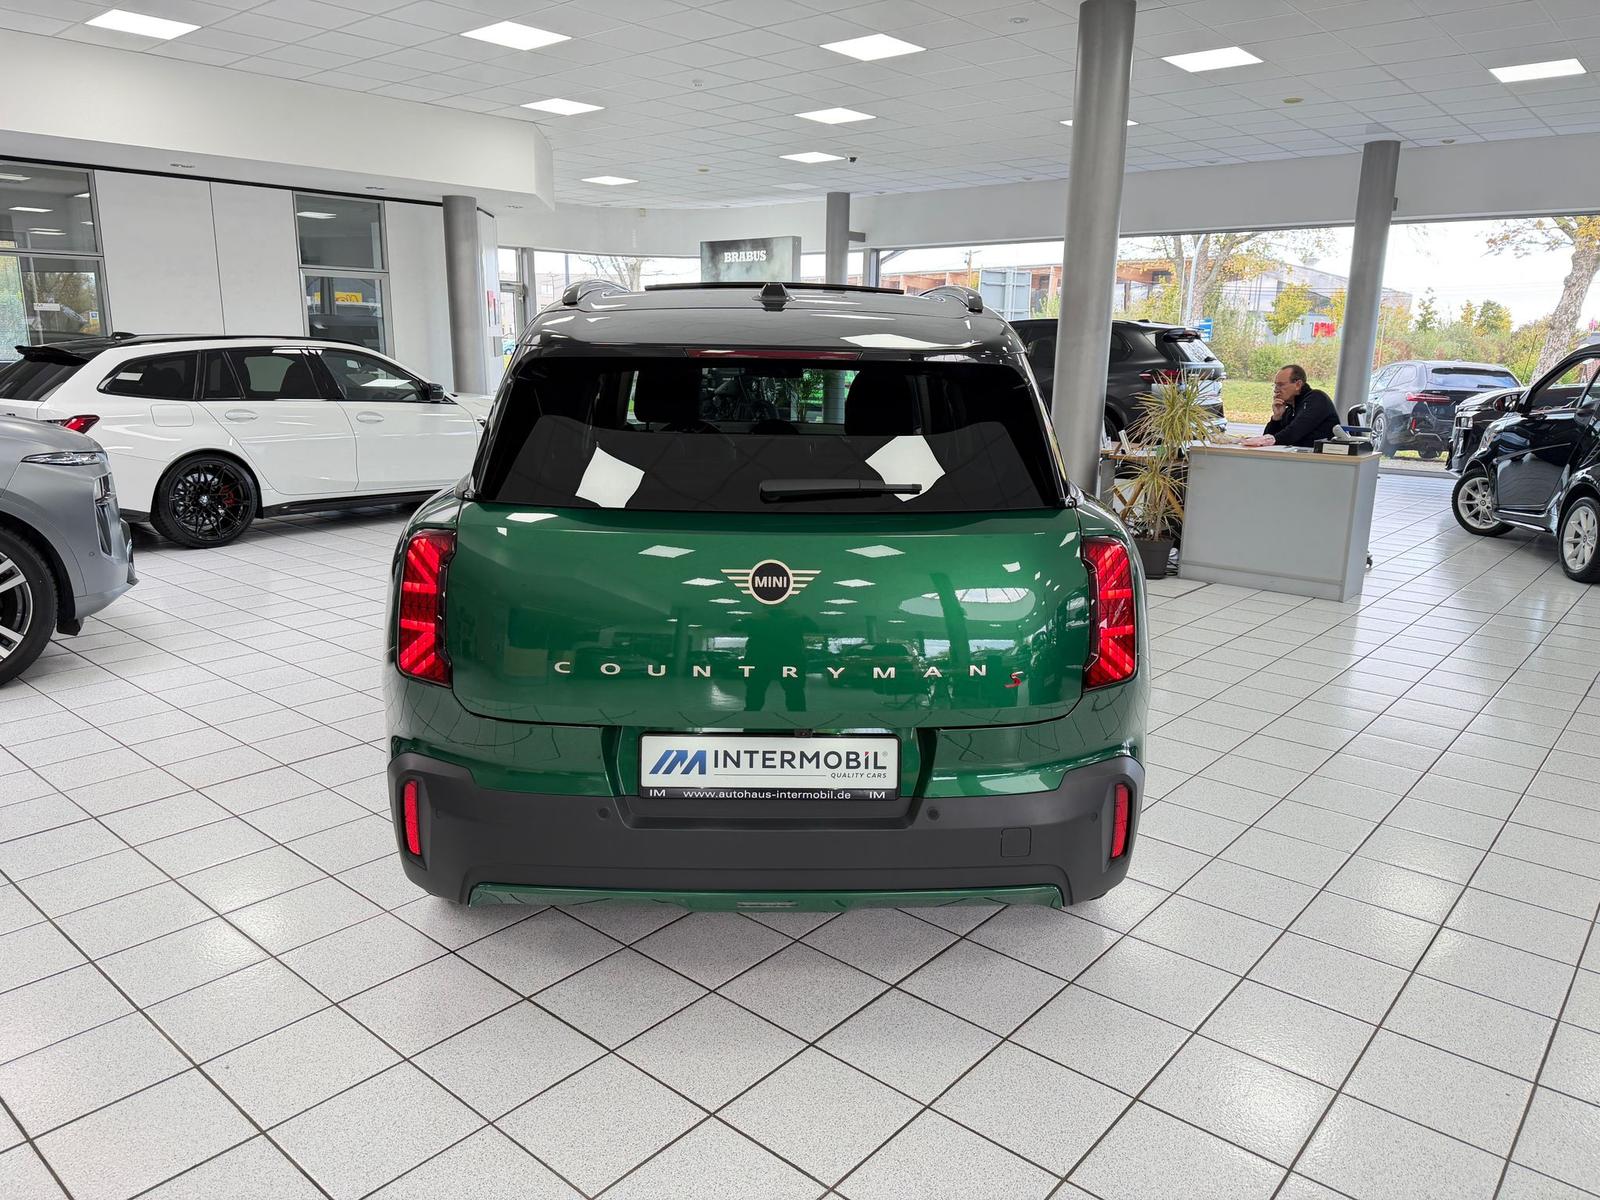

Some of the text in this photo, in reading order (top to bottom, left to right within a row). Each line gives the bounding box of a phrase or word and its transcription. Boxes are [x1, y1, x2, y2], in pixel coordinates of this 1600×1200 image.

[723, 250, 767, 263] BRABUS
[754, 576, 787, 588] MINI
[554, 661, 986, 679] COUNTRYMAN
[649, 789, 886, 799] IM www.autohaus-intermobil.de IM
